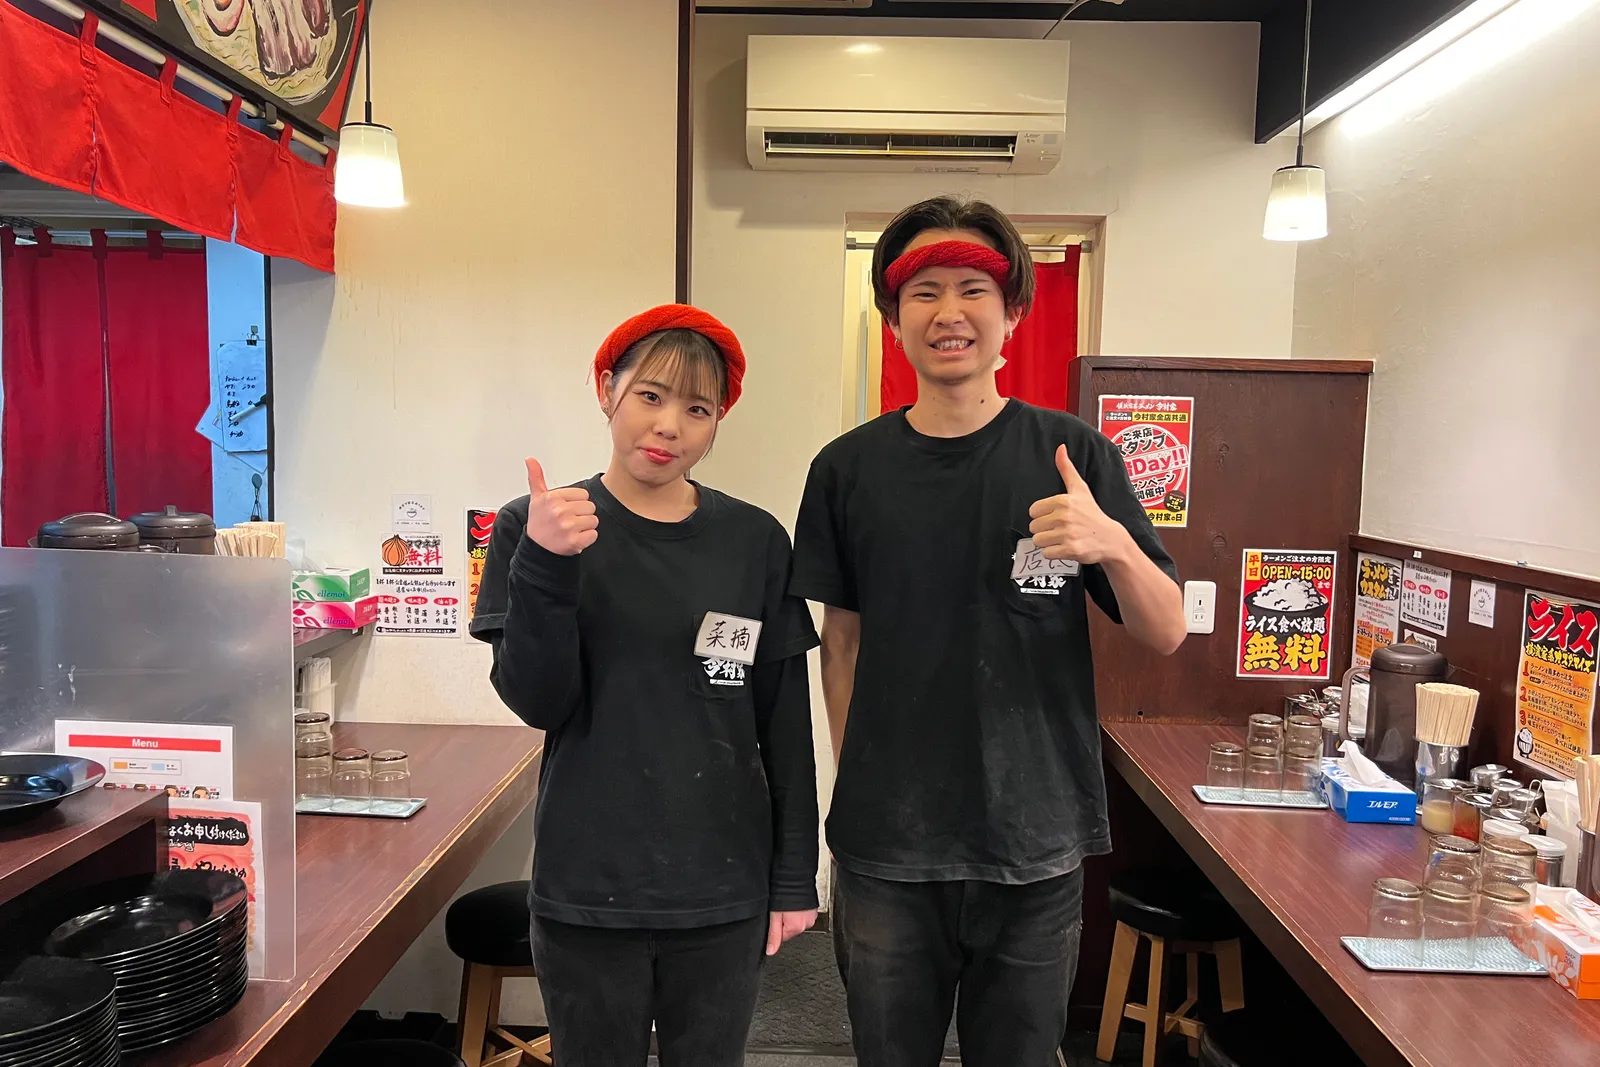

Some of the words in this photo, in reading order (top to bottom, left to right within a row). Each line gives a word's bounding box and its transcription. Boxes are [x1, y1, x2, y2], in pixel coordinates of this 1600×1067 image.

[1156, 402, 1177, 411] 今村家
[1134, 413, 1187, 422] 今村家全店共通
[1123, 427, 1152, 442] ご来店
[405, 547, 442, 566] 無料
[1263, 555, 1332, 563] ラーメンご注文の方限定
[472, 563, 480, 575] 1
[1248, 554, 1260, 577] 平日
[1245, 615, 1326, 634] ライス食べ放題
[1528, 598, 1598, 657] ライス
[706, 620, 750, 651] 菜摘
[1243, 631, 1326, 673] 無料
[1523, 661, 1529, 676] 1
[1520, 686, 1527, 702] 2
[1520, 710, 1526, 725] 3
[132, 739, 158, 748] Menu
